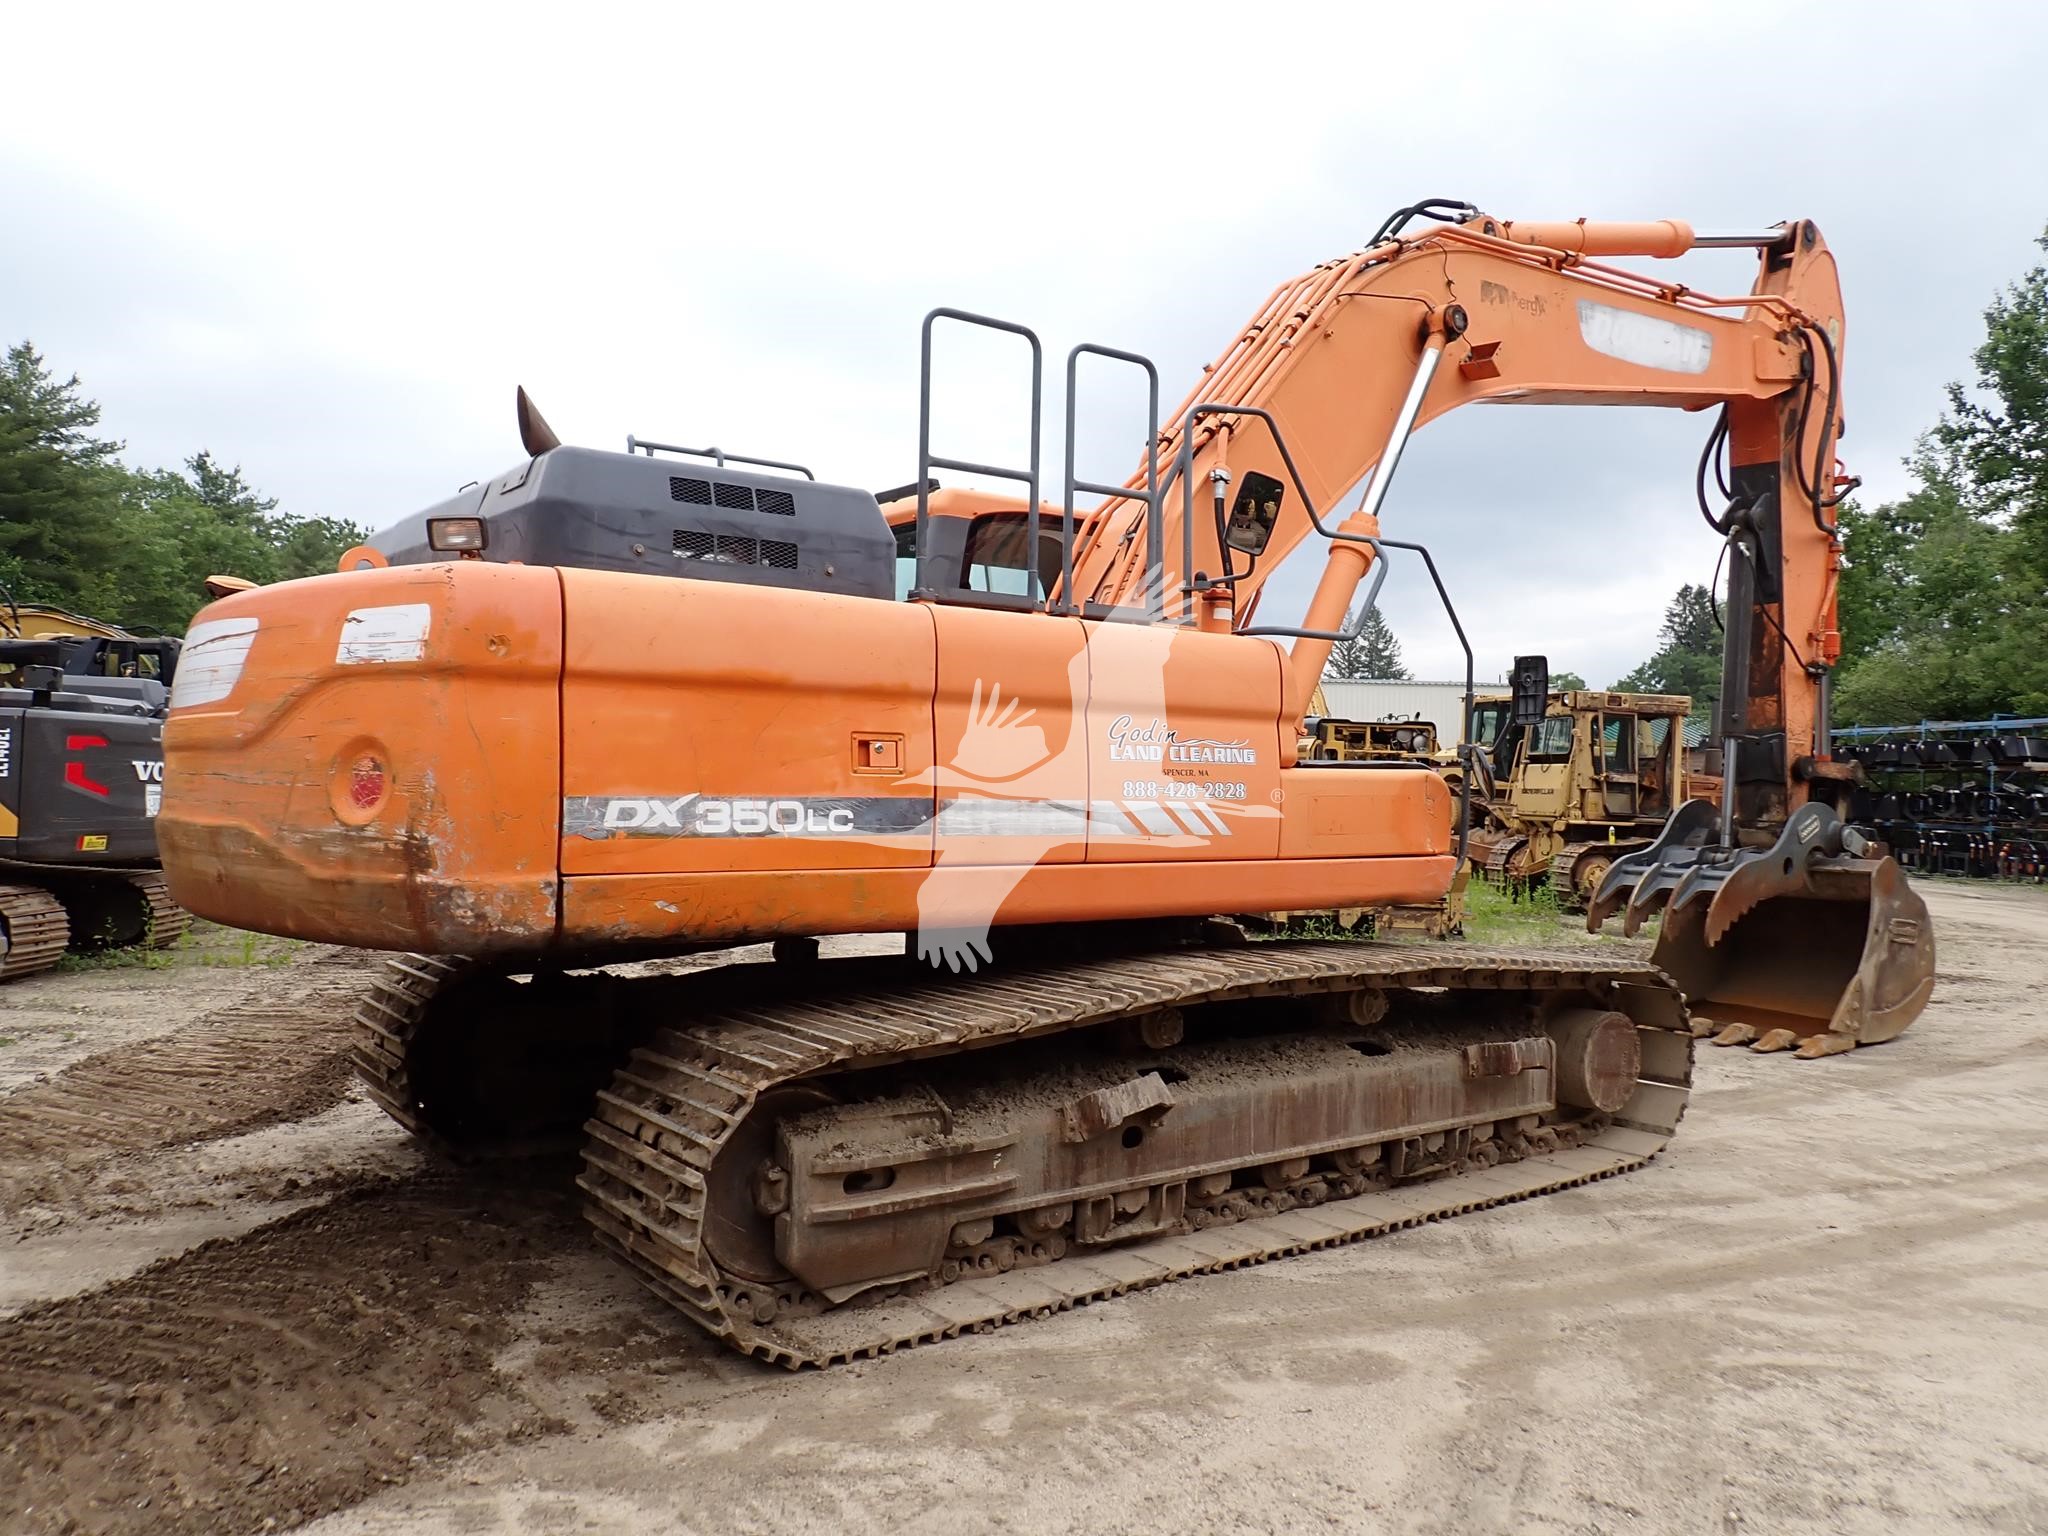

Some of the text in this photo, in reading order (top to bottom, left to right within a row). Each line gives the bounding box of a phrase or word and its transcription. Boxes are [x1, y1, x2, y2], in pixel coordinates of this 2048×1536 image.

[1109, 714, 1177, 749] Godin
[1109, 744, 1256, 764] LAND CLEARING
[1198, 769, 1209, 777] MA
[1122, 780, 1246, 799] 888-428-2828
